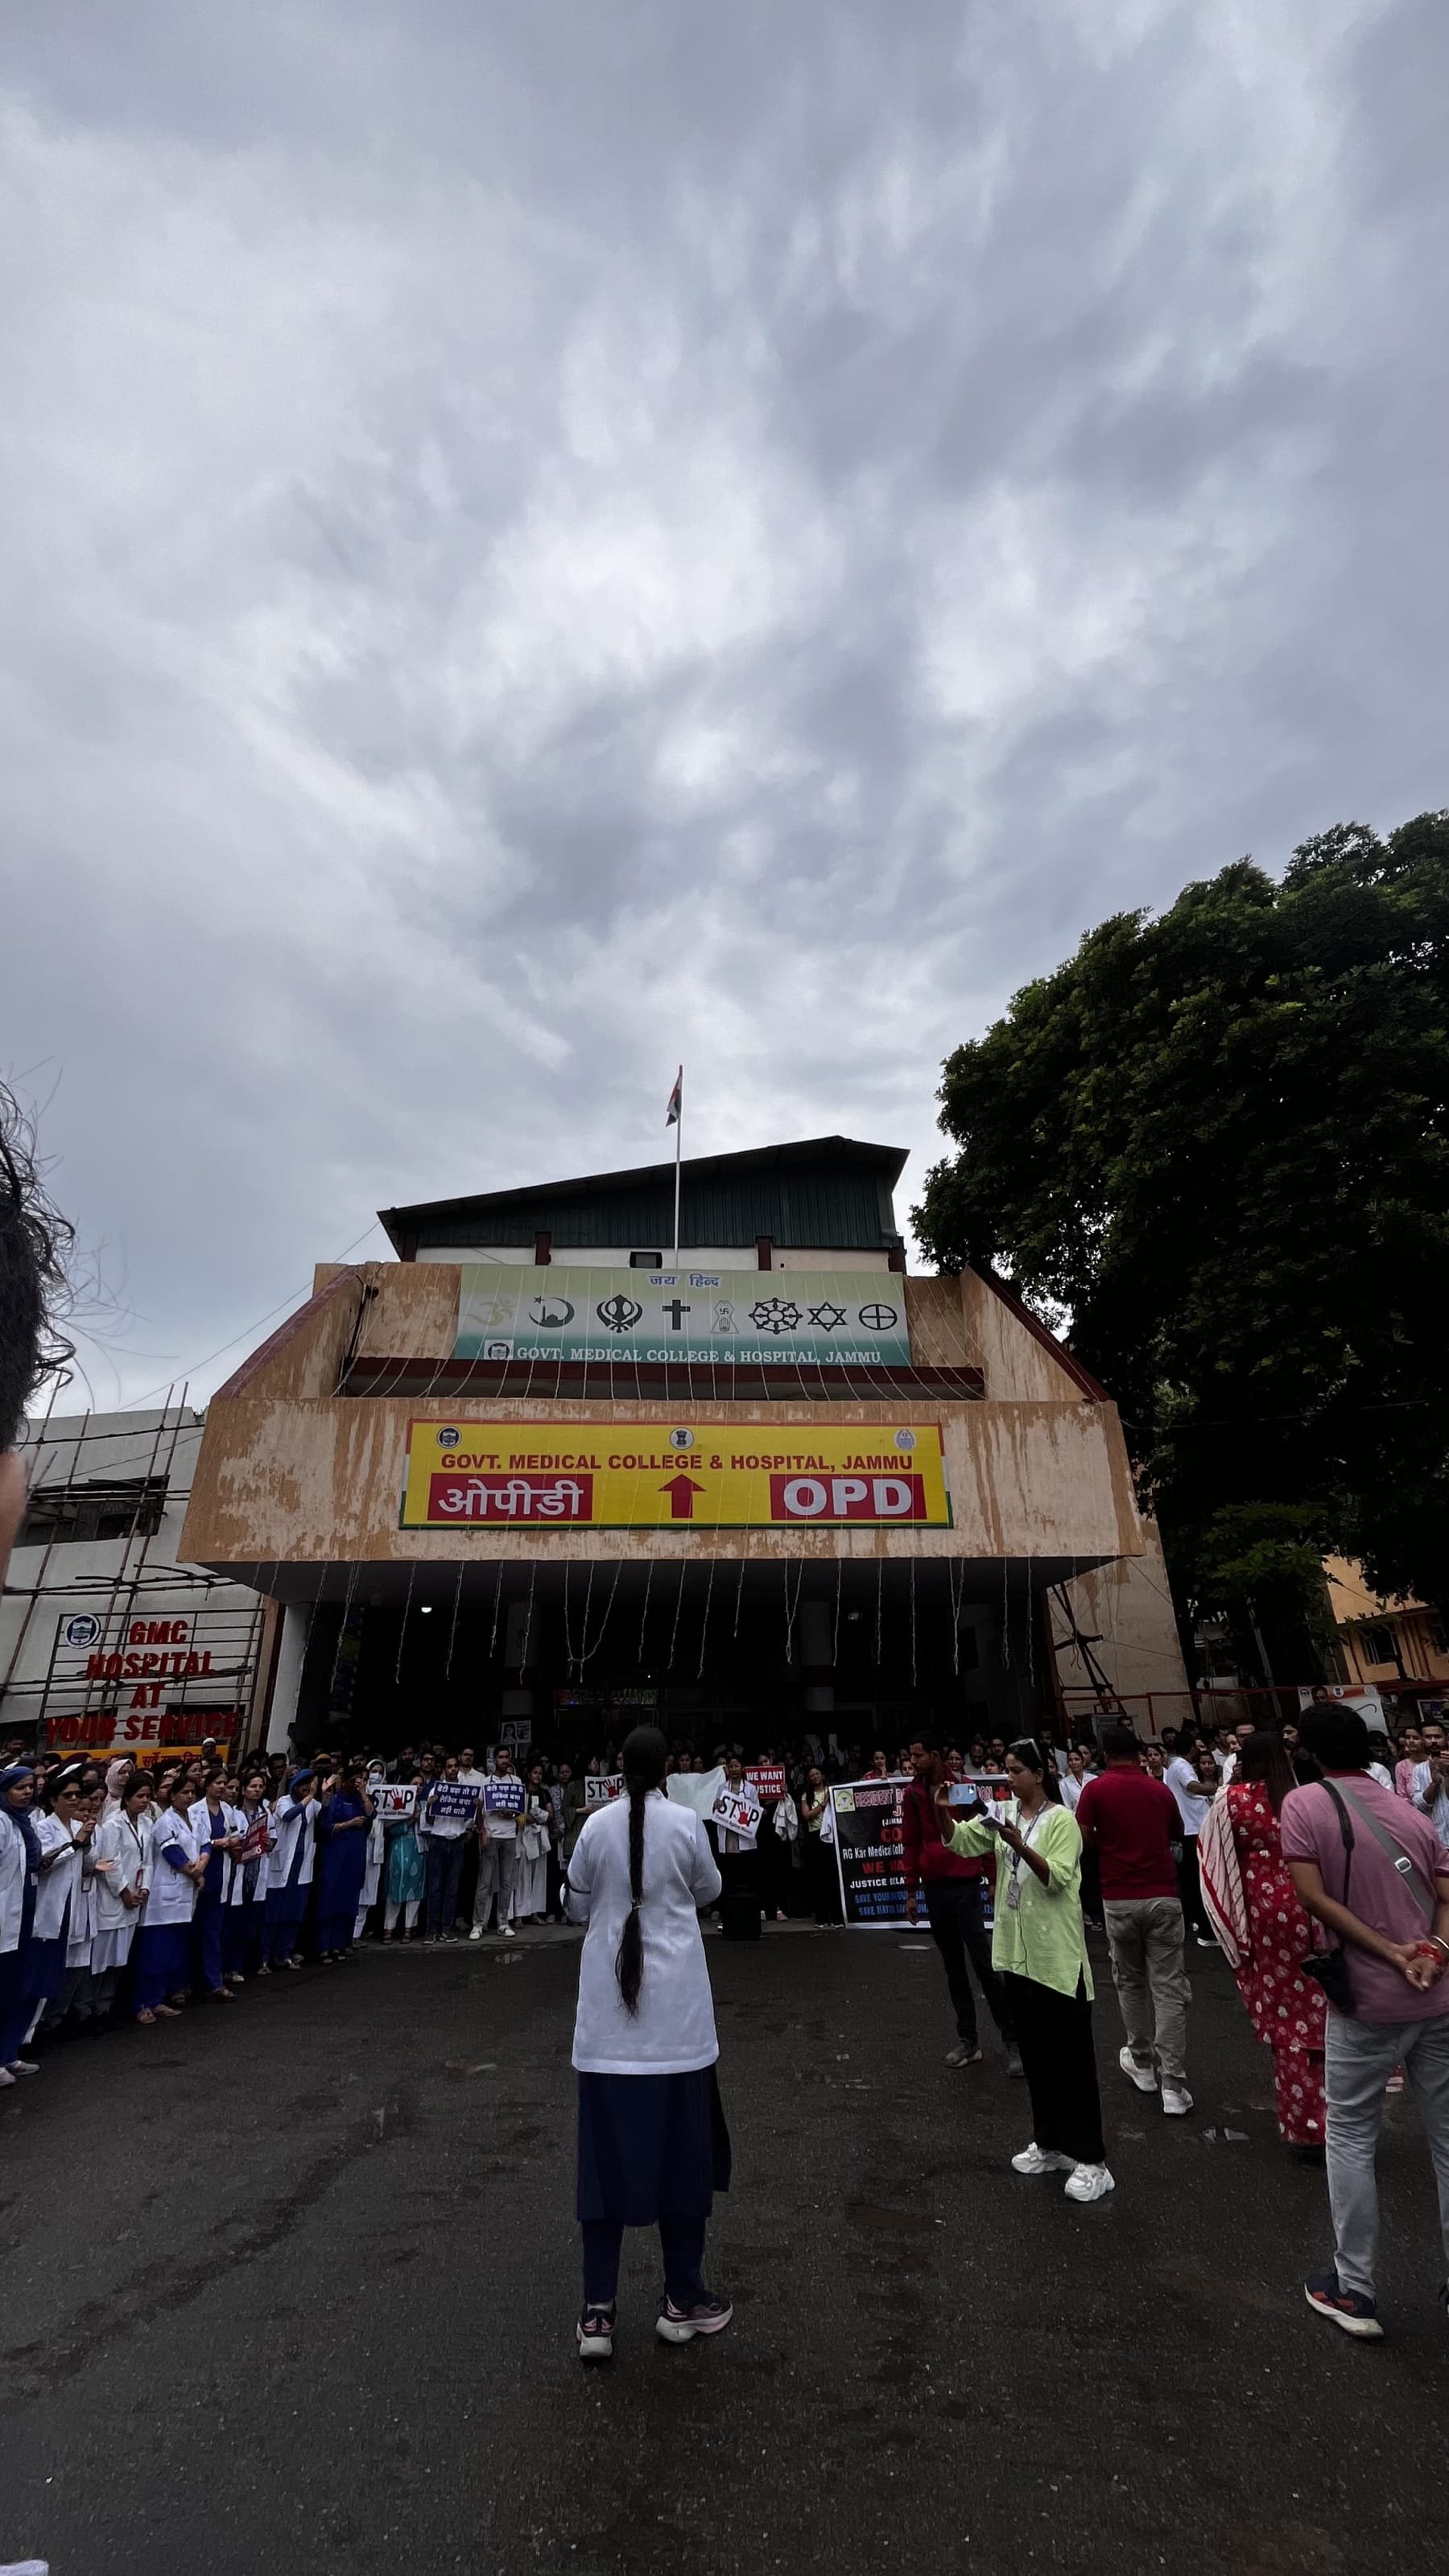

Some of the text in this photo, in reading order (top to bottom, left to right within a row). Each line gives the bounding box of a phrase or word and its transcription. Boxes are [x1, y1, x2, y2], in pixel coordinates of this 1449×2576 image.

[649, 1272, 721, 1288] जय हिन्द
[516, 1348, 881, 1365] GOVT. MEDICAL COLLEGE & HOSPITAL, JAMMU
[440, 1454, 913, 1472] GOVT. MEDICAL COLLEGE & HOSPITAL, JAMMU
[438, 1478, 584, 1516] ओपीडी
[782, 1478, 913, 1516] OPD
[129, 1620, 188, 1645] GMC
[85, 1650, 214, 1680] HOSPITAL
[130, 1682, 166, 1709] AT
[47, 1712, 239, 1744] YOUR SERVICE
[746, 1770, 783, 1781] WE WANT
[854, 1789, 894, 1808] RESIDENT
[842, 1848, 853, 1860] RG
[855, 1847, 866, 1860] Kar
[868, 1844, 892, 1858] Medical
[861, 1860, 885, 1876] WE
[850, 1878, 887, 1889] JUSTICE
